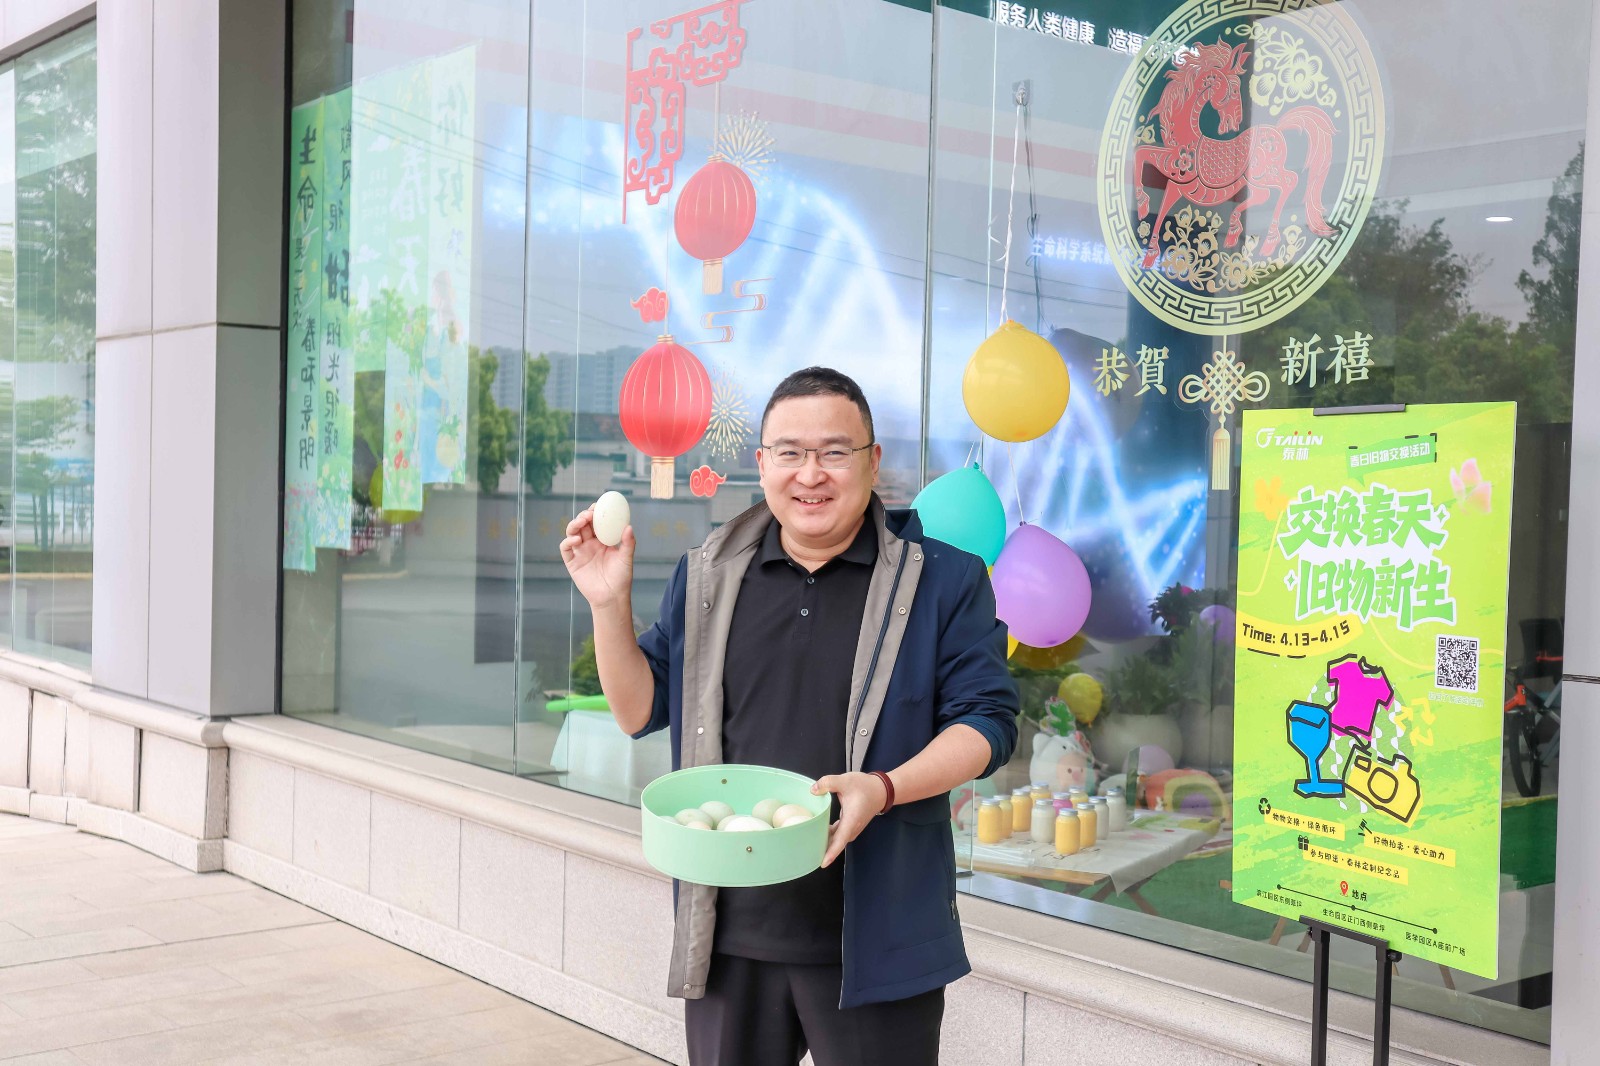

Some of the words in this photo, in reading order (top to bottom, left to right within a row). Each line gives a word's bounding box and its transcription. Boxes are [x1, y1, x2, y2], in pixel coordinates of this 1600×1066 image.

[991, 0, 1096, 44] 服务人类健康
[1091, 343, 1170, 398] 恭賀
[1279, 330, 1375, 389] 新禧
[1282, 447, 1309, 461] 泰林
[1350, 442, 1431, 468] 春日旧物交换活动
[1278, 484, 1447, 557] 交换春天
[1296, 556, 1455, 630] 旧物新生
[1242, 622, 1276, 644] Time:
[1280, 619, 1351, 647] 4.13-4.15
[1351, 888, 1368, 902] 地点
